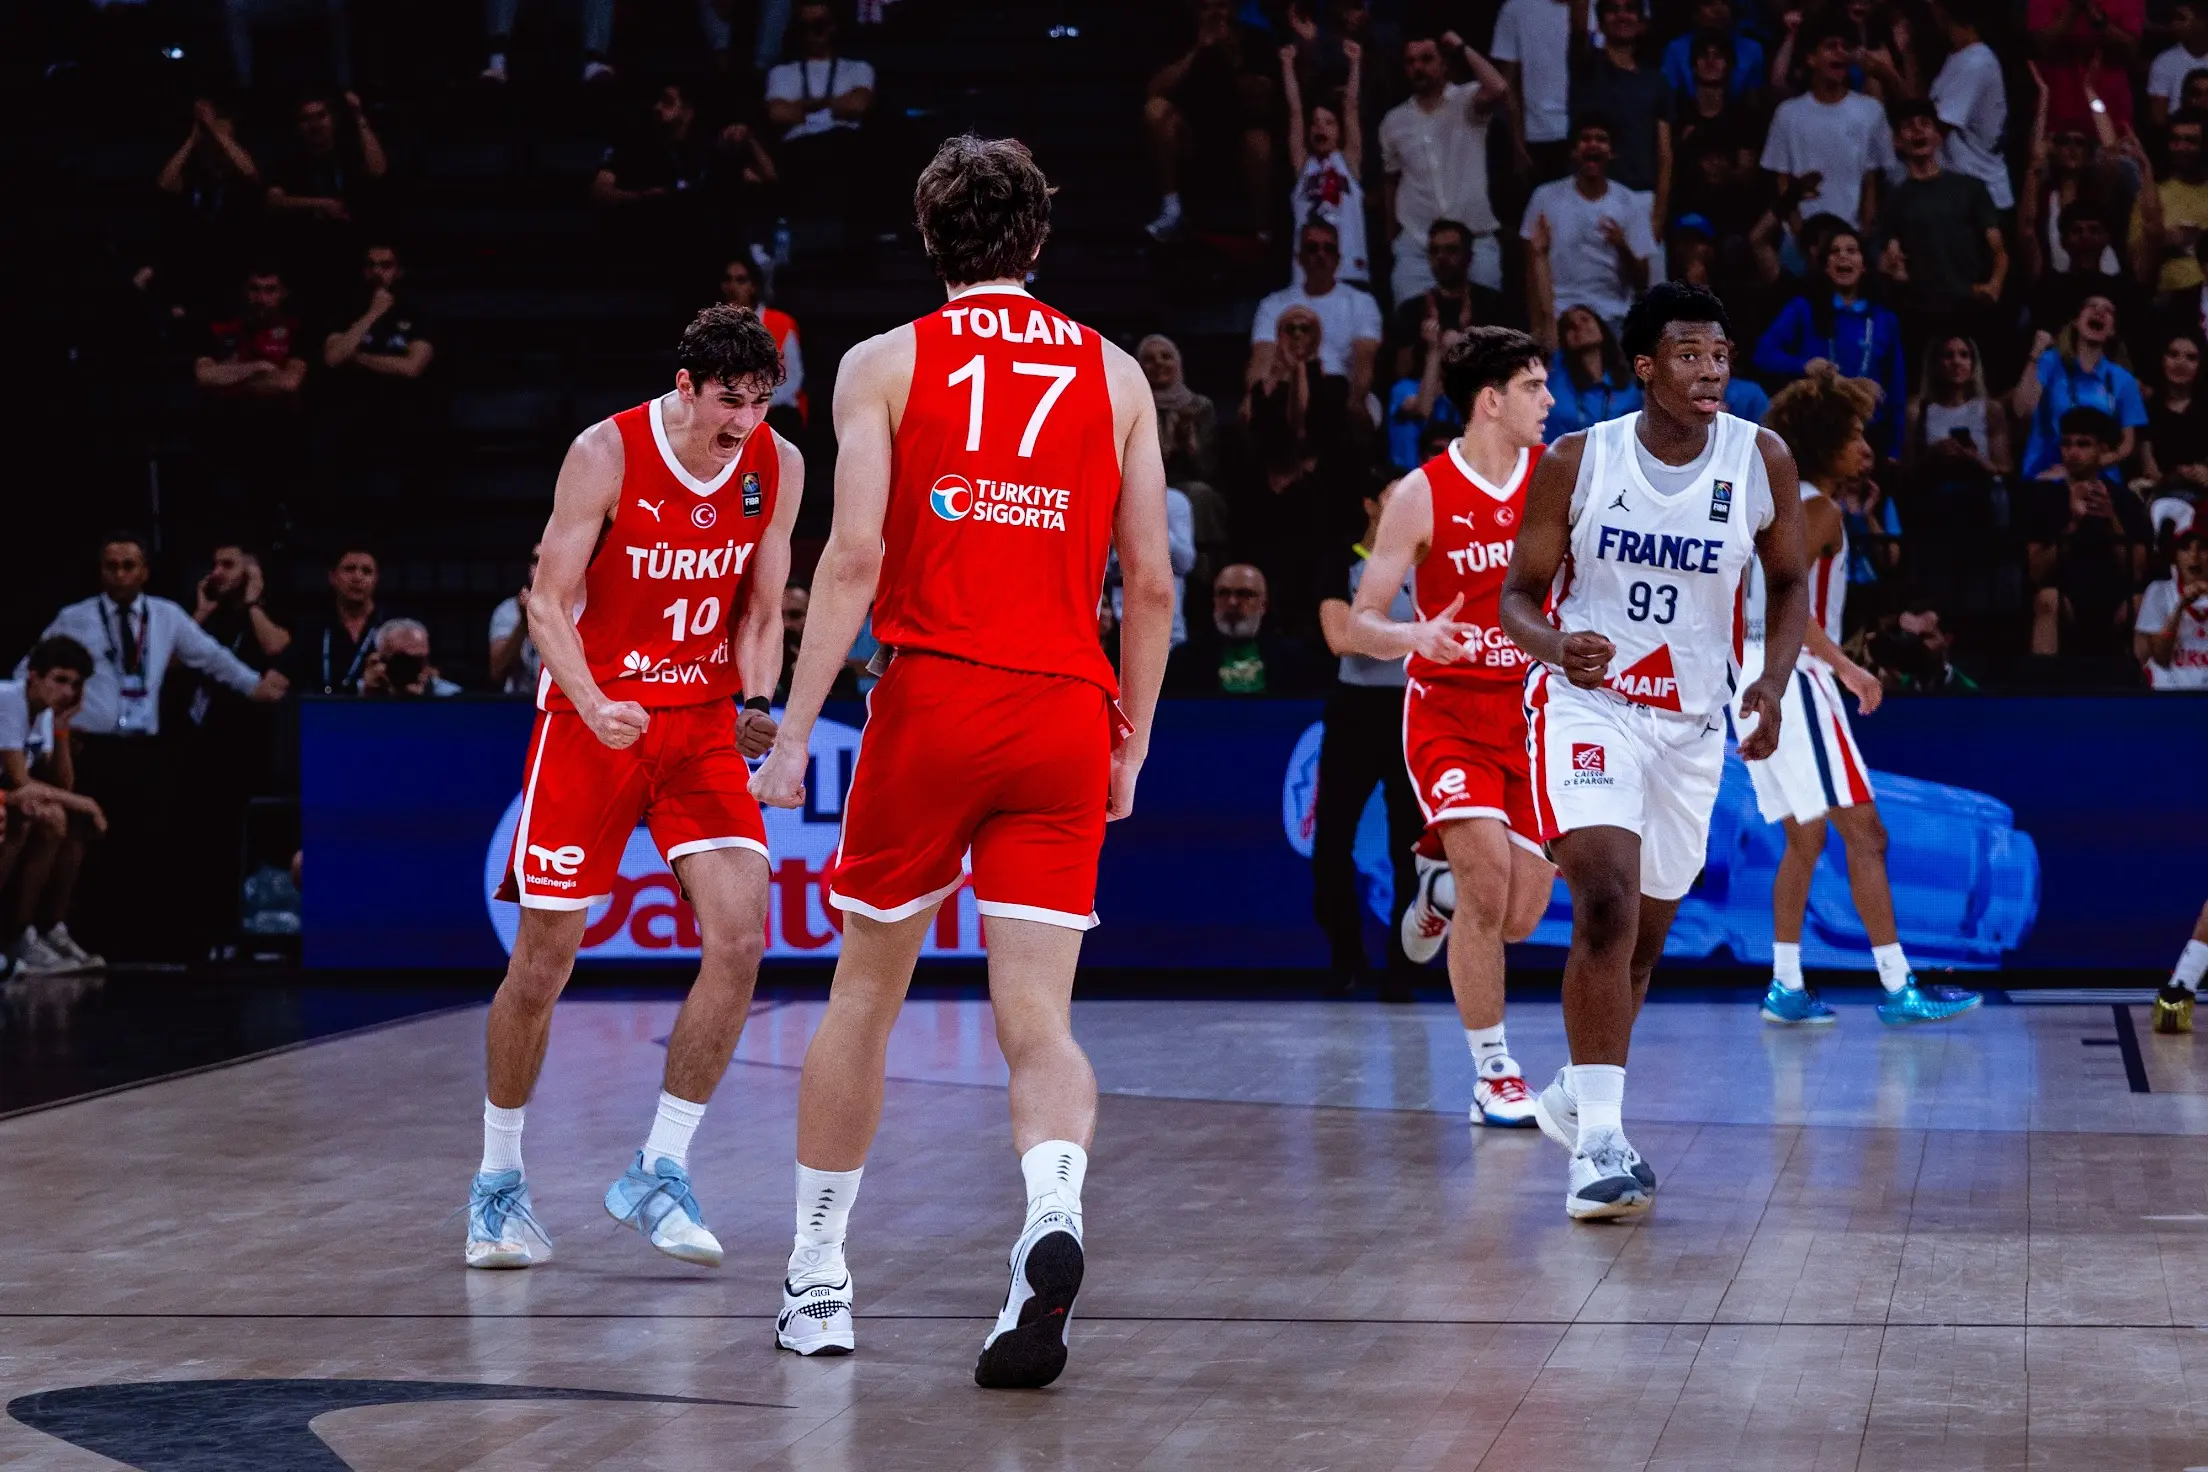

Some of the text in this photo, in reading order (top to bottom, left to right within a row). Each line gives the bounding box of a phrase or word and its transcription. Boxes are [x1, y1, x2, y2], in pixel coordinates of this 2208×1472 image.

[942, 307, 1083, 346] TOLAN
[948, 354, 1077, 458] 17
[626, 539, 754, 581] TÜRKİY
[1596, 524, 1724, 574] FRANCE
[663, 596, 720, 642] 10
[1627, 580, 1678, 625] 93
[1611, 674, 1677, 698] MAIF
[810, 1288, 831, 1298] GIGI
